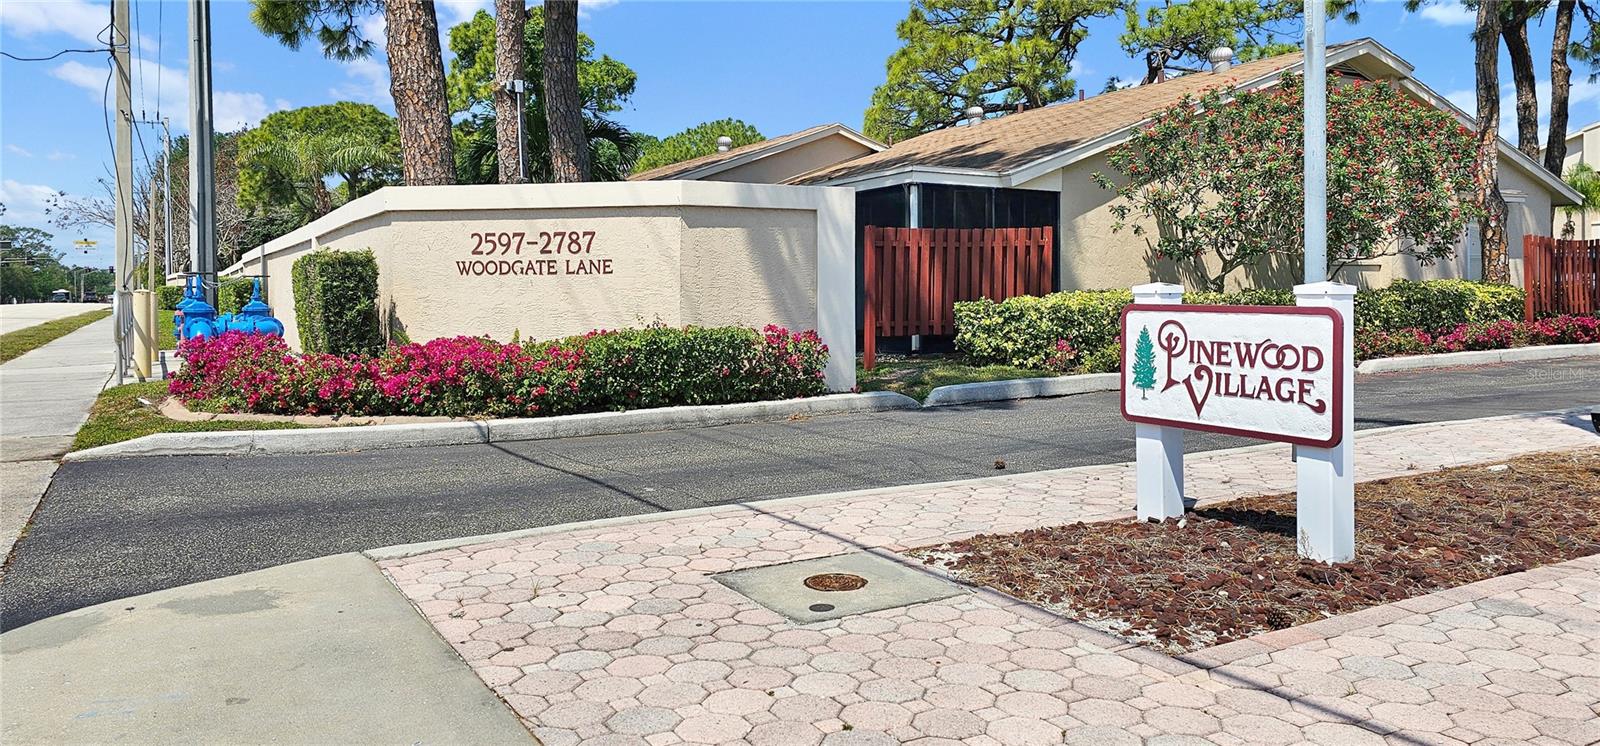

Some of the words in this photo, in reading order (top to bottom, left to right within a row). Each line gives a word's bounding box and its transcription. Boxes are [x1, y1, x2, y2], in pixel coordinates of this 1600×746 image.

[470, 231, 596, 256] 2597-2787
[456, 259, 558, 276] WOODGATE
[565, 259, 614, 275] LANE
[1158, 319, 1324, 393] PINEWOOD
[1182, 364, 1327, 418] VILLAGE
